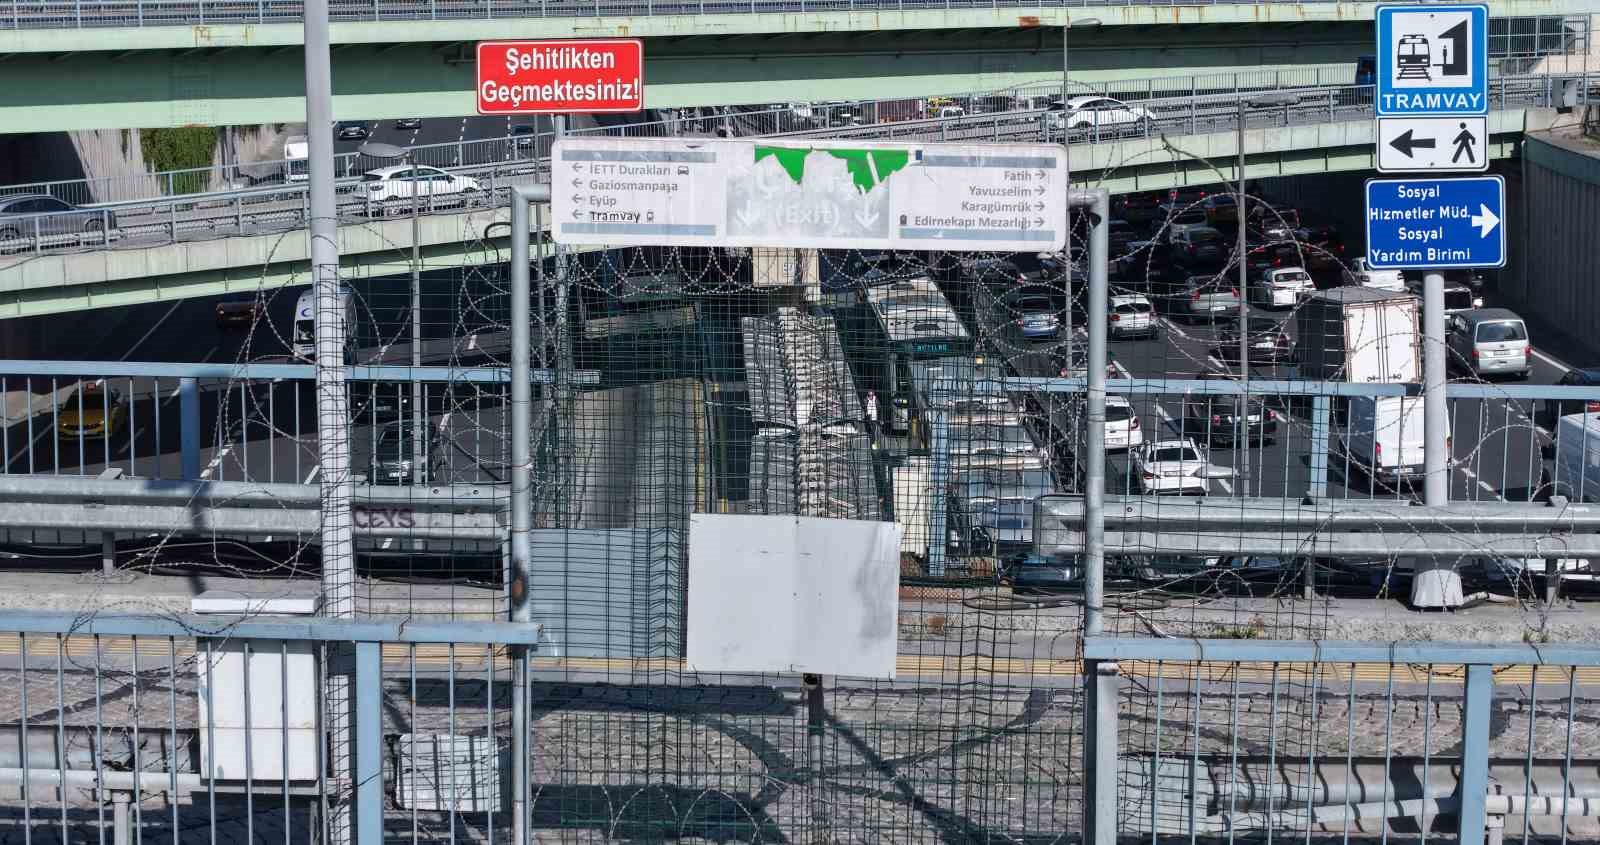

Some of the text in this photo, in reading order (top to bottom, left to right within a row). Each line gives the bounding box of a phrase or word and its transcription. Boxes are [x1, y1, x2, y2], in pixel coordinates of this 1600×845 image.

[505, 47, 615, 75] Şehitlikten
[481, 78, 640, 107] Geçmektesiniz!
[1382, 93, 1481, 109] TRAMVAY
[590, 162, 671, 176] İETT Durakları
[1004, 170, 1032, 181] Fatih
[589, 180, 679, 193] Gaziosmanpaşa
[969, 185, 1032, 197] Yavuzselim
[1397, 185, 1440, 201] Sosyal
[590, 195, 617, 207] Eyüp
[961, 201, 1032, 213] Karagümrük
[589, 210, 641, 223] Tramvay
[1369, 205, 1471, 221] Hizmetler Müd.
[914, 216, 1032, 230] Edirnekapı Mezarlığı
[1398, 226, 1443, 242] Sosyal
[1371, 247, 1471, 263] Yardım Birimi
